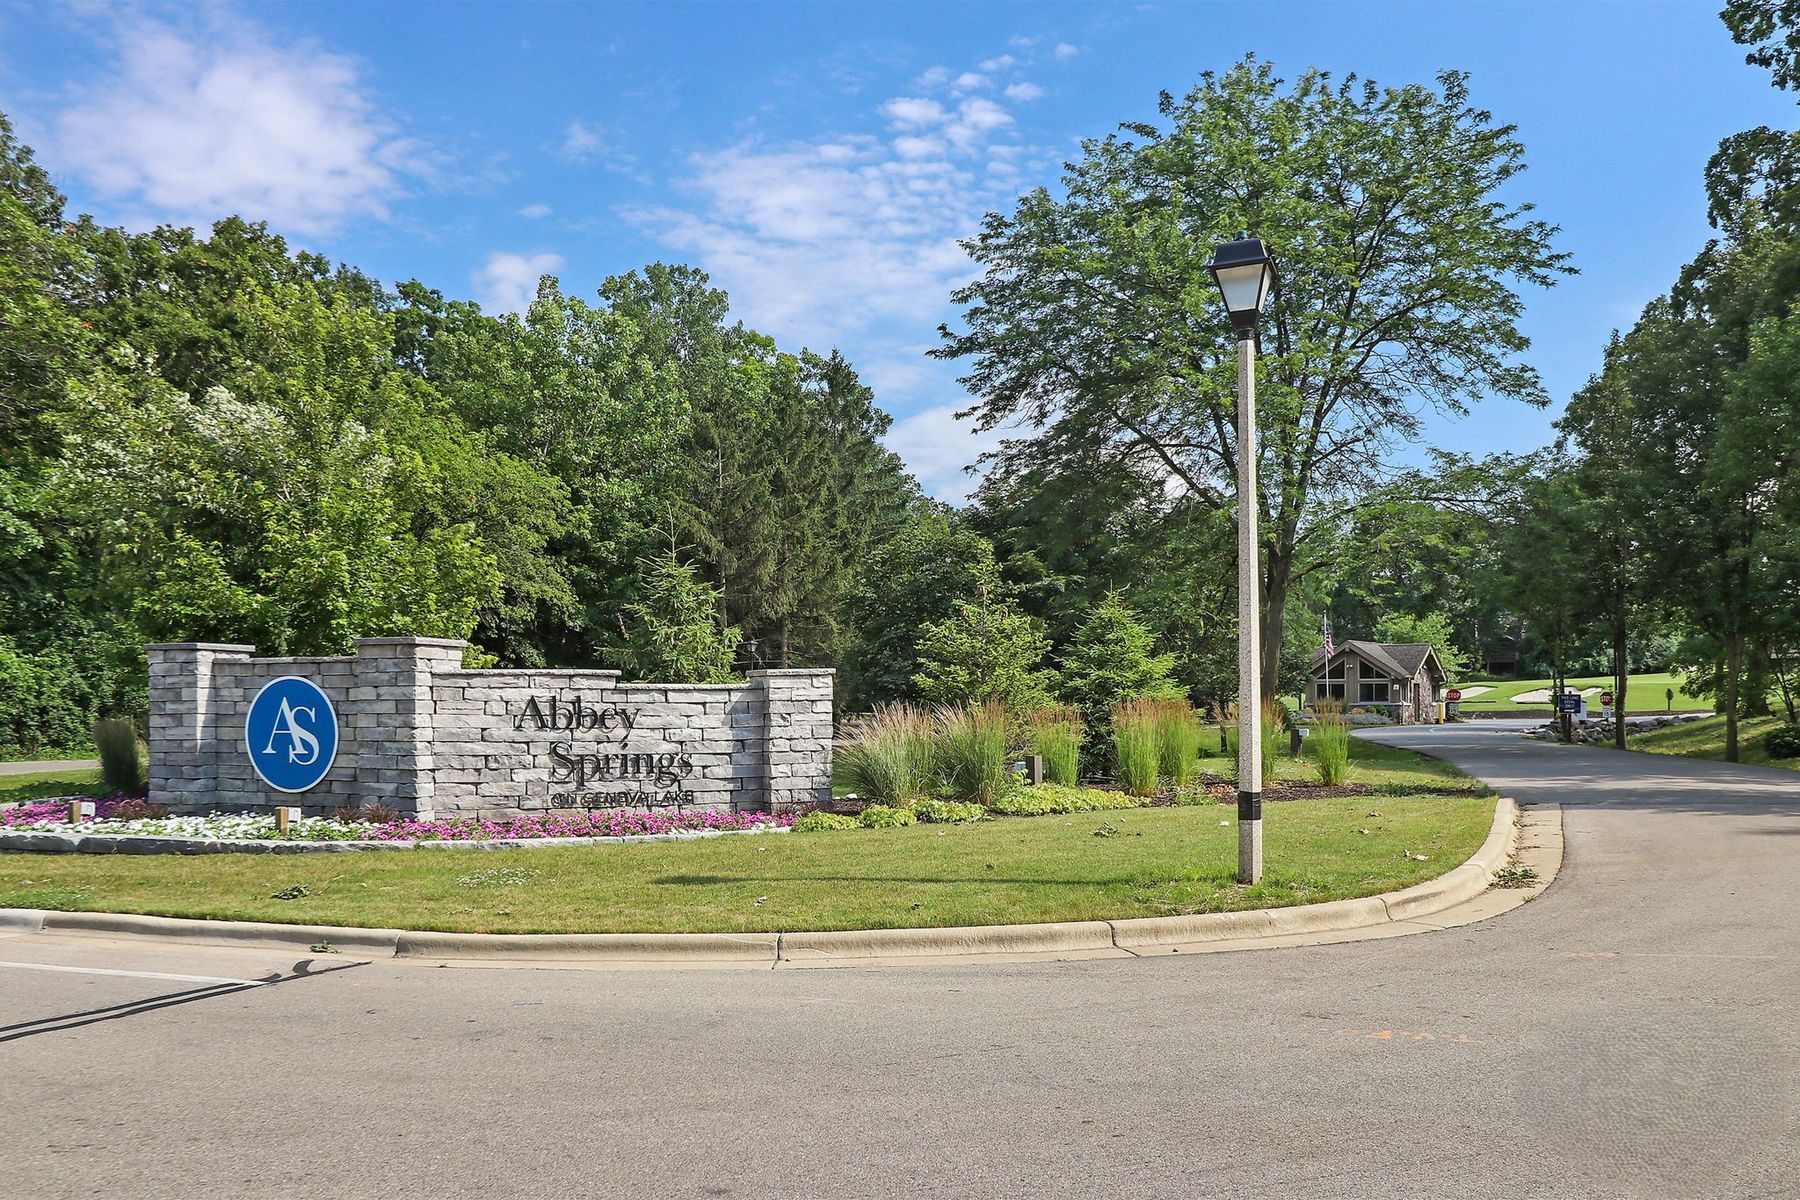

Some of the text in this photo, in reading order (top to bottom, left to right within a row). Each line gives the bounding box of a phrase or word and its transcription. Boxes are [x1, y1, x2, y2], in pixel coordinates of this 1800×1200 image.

[262, 696, 320, 765] AS
[514, 695, 642, 744] Abbey
[550, 741, 694, 790] Springs
[551, 789, 695, 808] ON GENEVA LAKE
